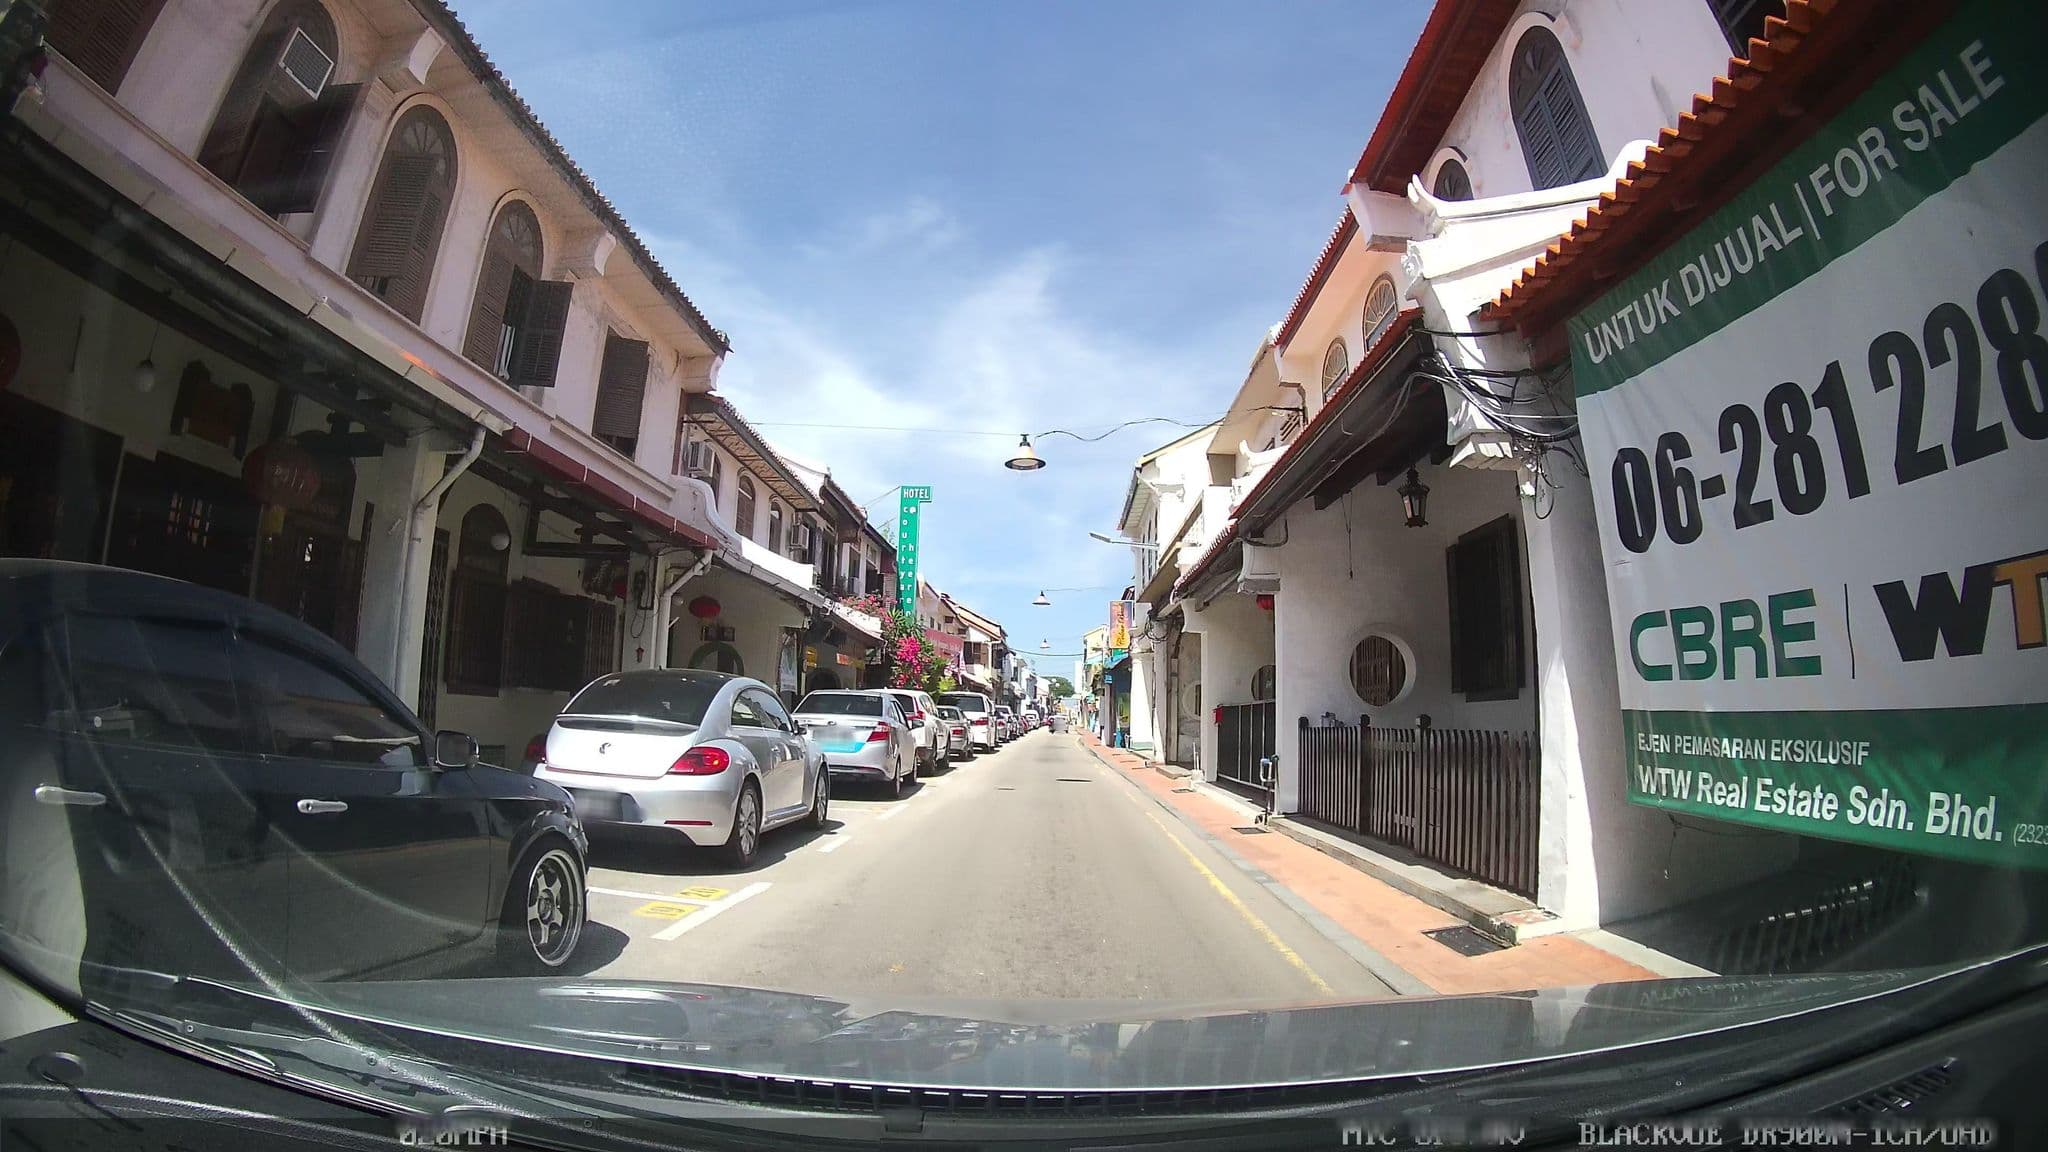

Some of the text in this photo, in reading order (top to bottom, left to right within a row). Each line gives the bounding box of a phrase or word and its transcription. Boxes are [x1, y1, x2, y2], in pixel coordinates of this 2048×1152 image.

[1584, 39, 2006, 364] UNTUK DIJUAL FOR SALE
[1868, 241, 2048, 485] 228
[903, 488, 930, 499] HOTEL
[1630, 588, 1822, 682] CBRE
[1638, 733, 1870, 766] EJEN PEMASARAN EKSKLUSIF
[1638, 764, 1692, 800] WTW
[1696, 771, 1748, 809] Real
[1754, 777, 1839, 821] Estate
[1846, 785, 1914, 831] Sdn.
[1925, 791, 2003, 842] Bhd.
